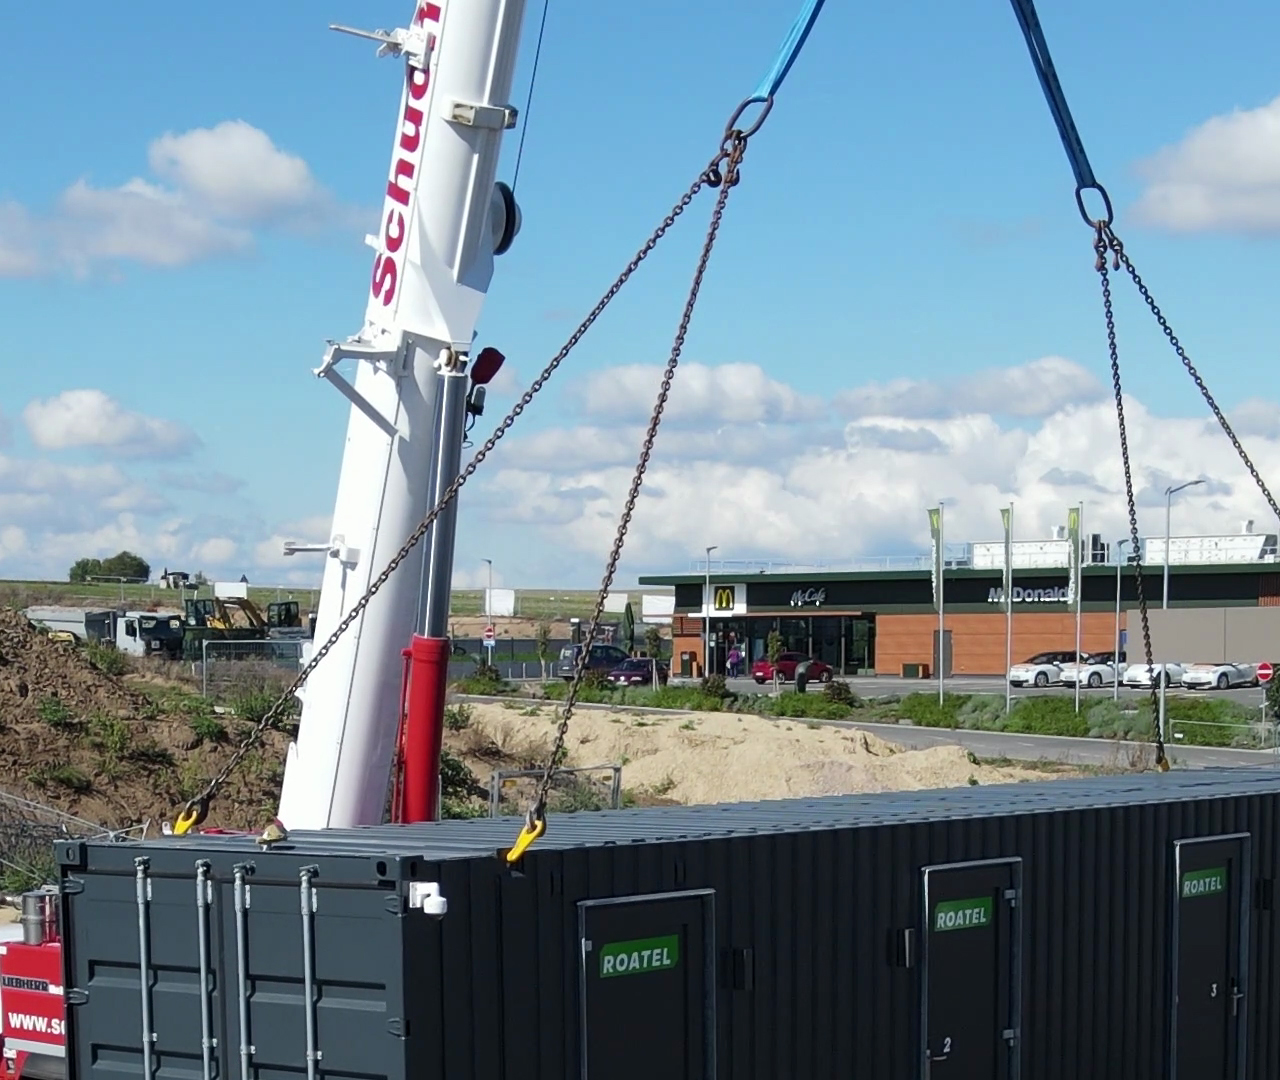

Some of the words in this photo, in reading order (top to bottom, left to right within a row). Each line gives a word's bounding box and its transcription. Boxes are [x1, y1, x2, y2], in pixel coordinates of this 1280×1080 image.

[1184, 877, 1222, 894] ROATEL
[936, 907, 986, 928] ROATEL
[603, 948, 671, 974] ROATEL
[2, 976, 50, 992] LIEBHERR
[1210, 983, 1217, 998] 3
[943, 1037, 952, 1053] 2
